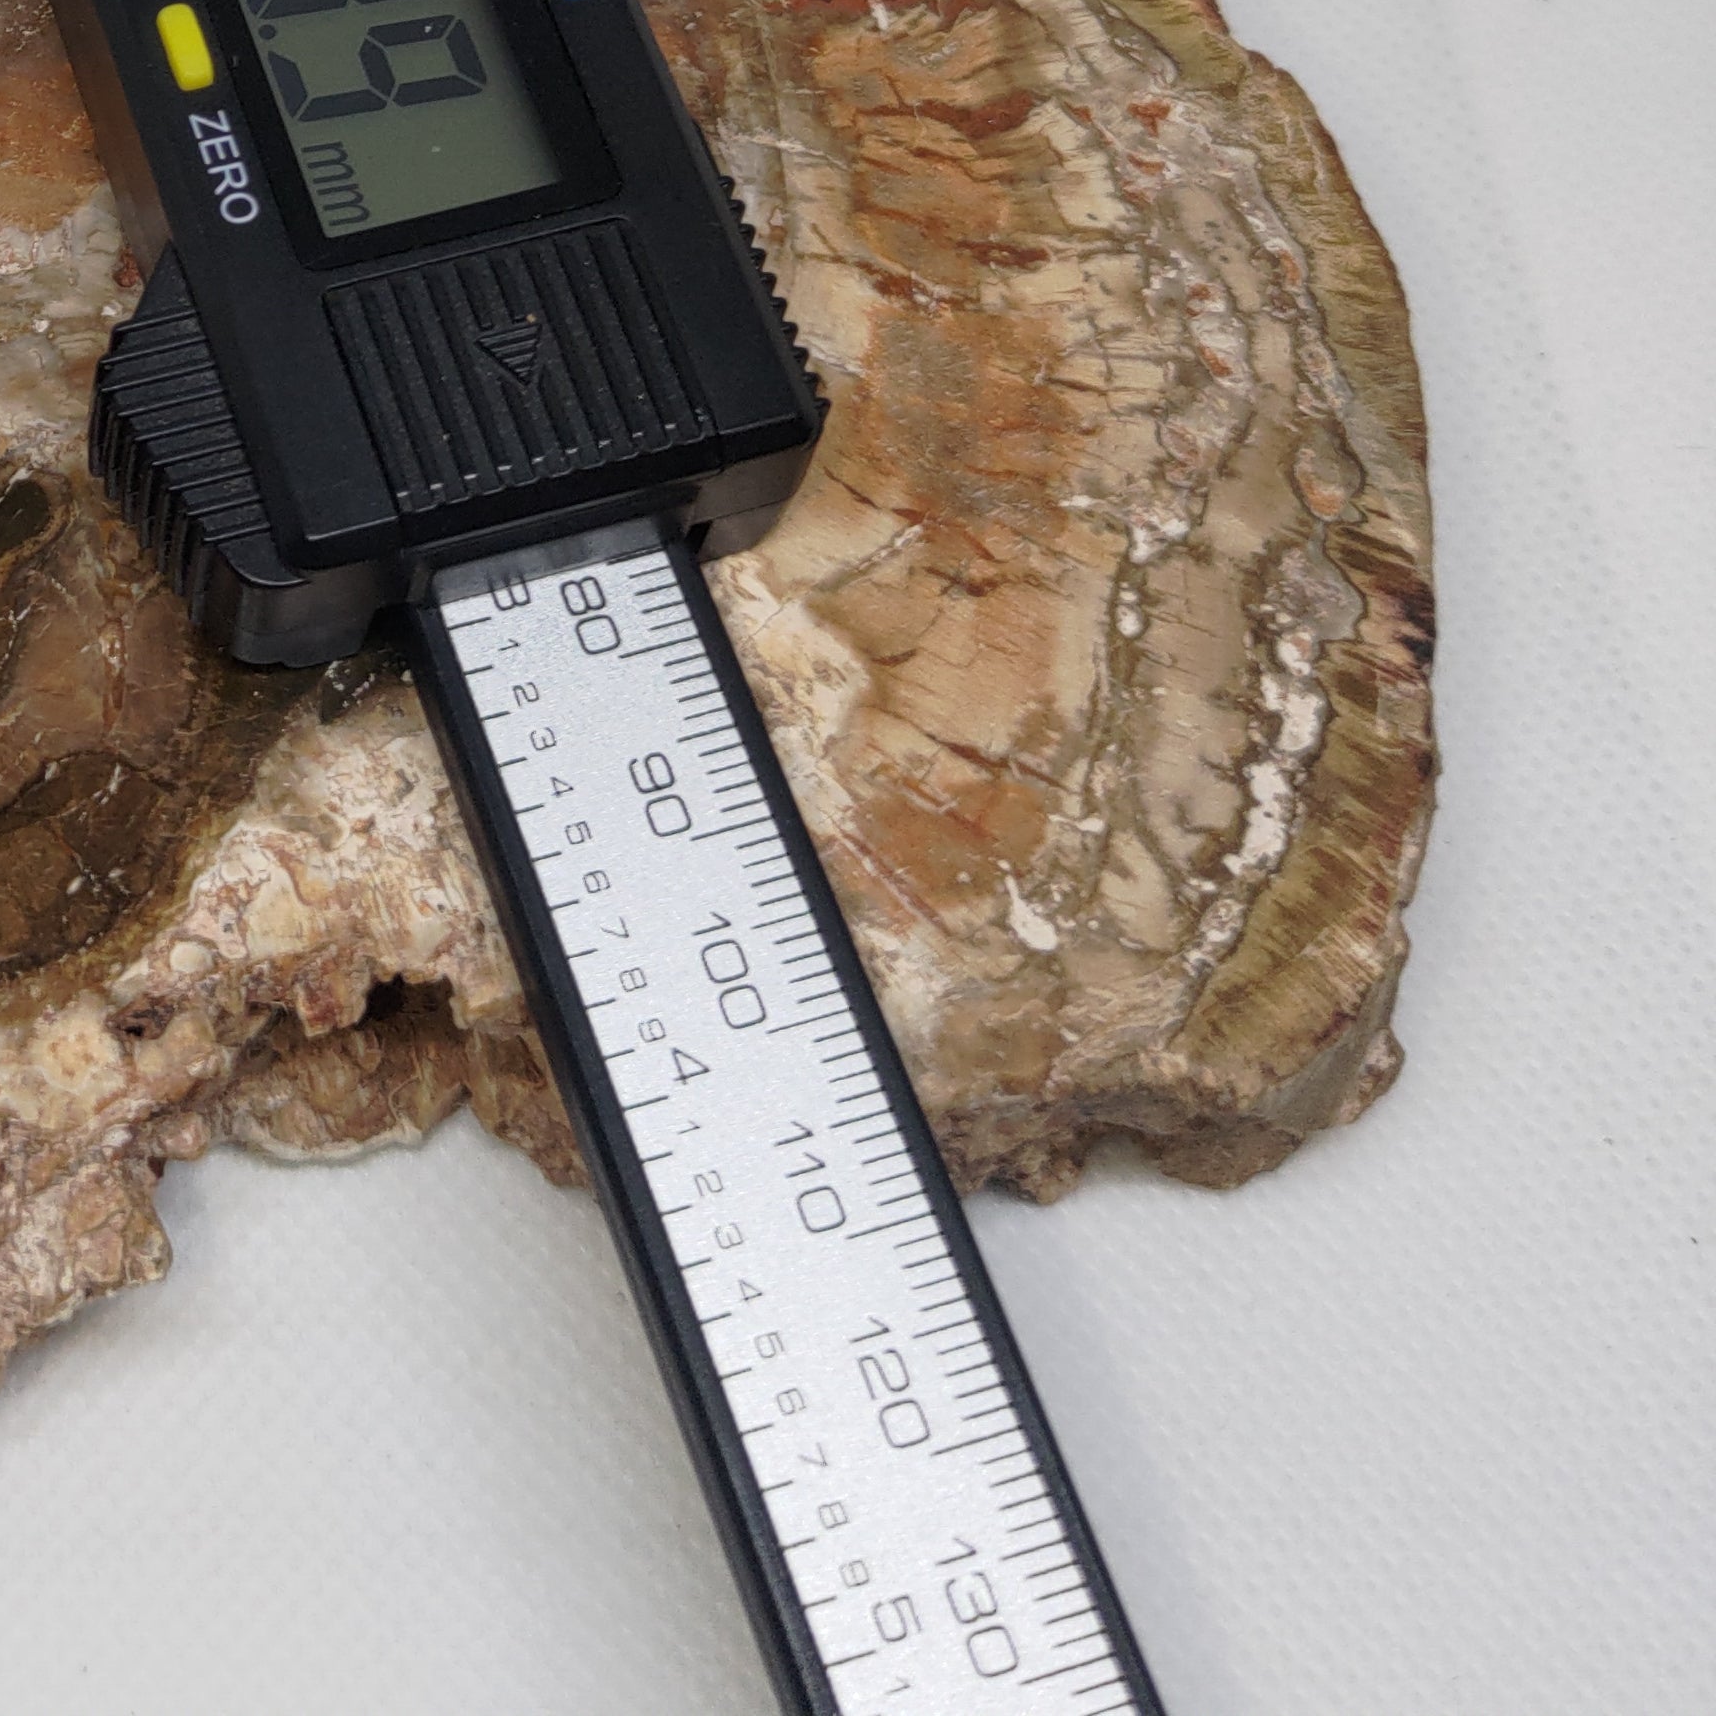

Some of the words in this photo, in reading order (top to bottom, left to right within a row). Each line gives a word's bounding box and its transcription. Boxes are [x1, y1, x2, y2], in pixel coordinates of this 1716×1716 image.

[188, 109, 260, 225] ZERO
[301, 140, 372, 228] mm
[486, 571, 532, 612] 3
[498, 639, 522, 653] 1
[512, 682, 541, 709] 2
[529, 726, 557, 752] 3
[549, 776, 574, 798] 4
[564, 820, 593, 845] 5
[582, 870, 612, 894] 6
[601, 916, 630, 939] 7
[619, 967, 648, 993] 8
[638, 1018, 667, 1043] 9
[670, 1047, 712, 1086] 4
[560, 577, 625, 657] 80
[627, 752, 693, 839] 90
[691, 911, 768, 1030] 100
[773, 1121, 847, 1234] 110
[848, 1317, 932, 1450] 120
[934, 1536, 1020, 1680] 130
[677, 1120, 702, 1135] 1
[693, 1170, 725, 1198] 2
[714, 1222, 744, 1250] 3
[738, 1279, 764, 1304] 4
[754, 1331, 785, 1359] 5
[775, 1388, 807, 1416] 6
[798, 1443, 829, 1468] 7
[818, 1500, 850, 1530] 8
[871, 1594, 924, 1645] 5
[885, 1677, 911, 1695] 1
